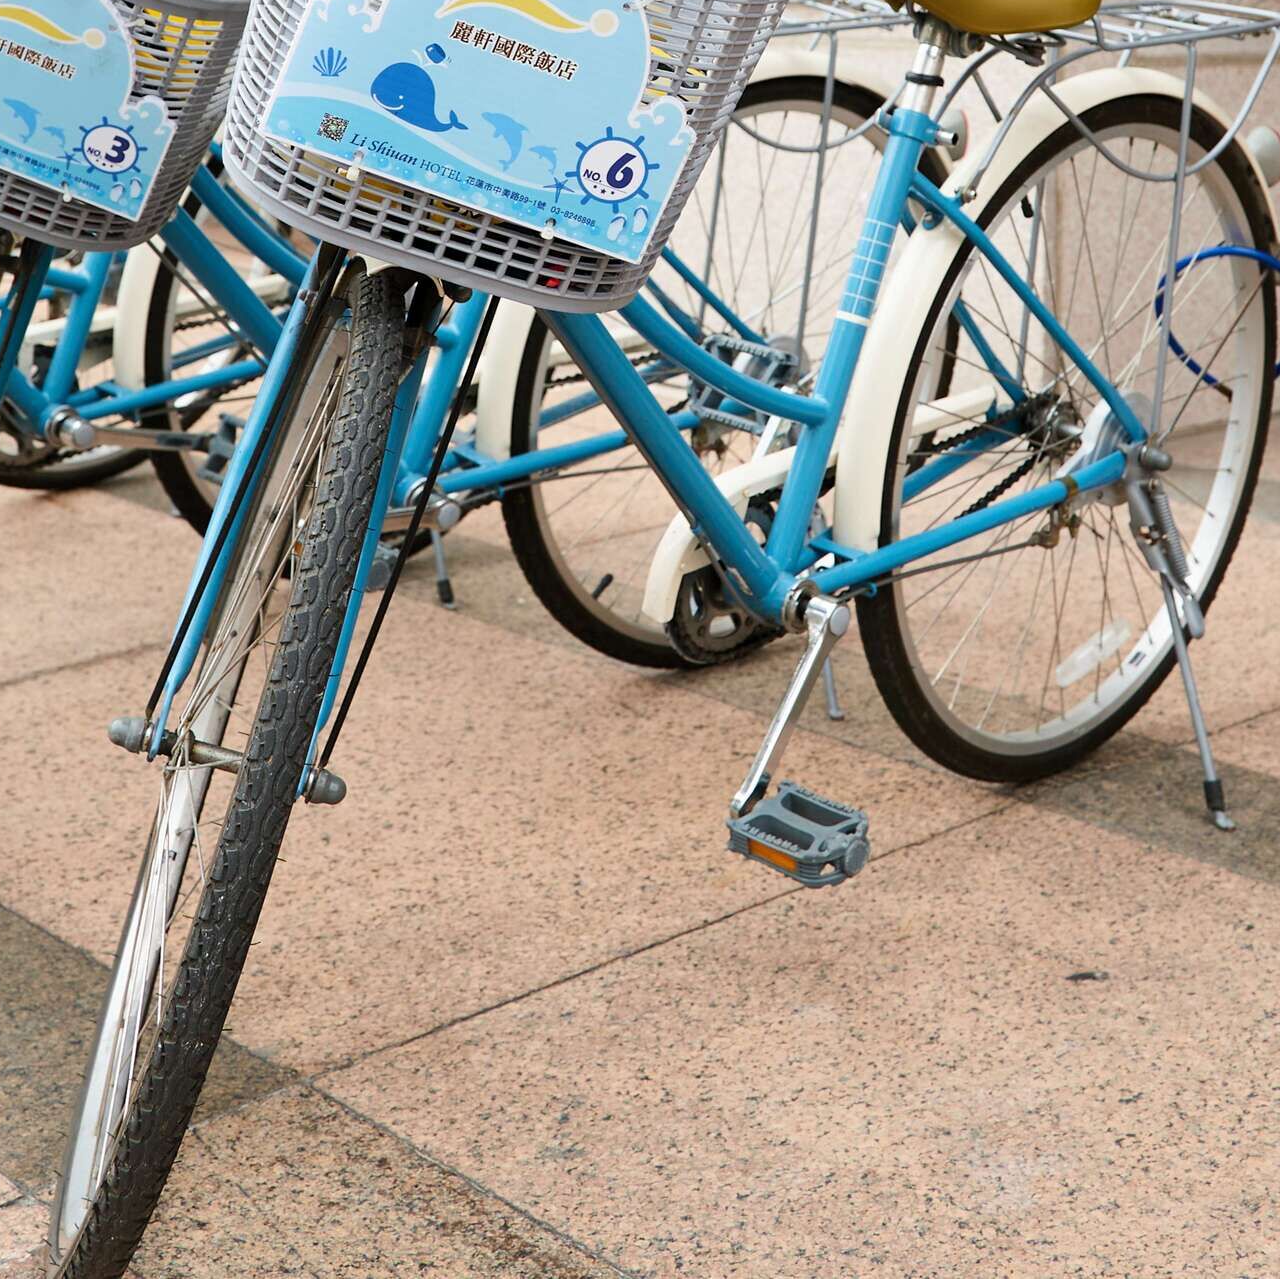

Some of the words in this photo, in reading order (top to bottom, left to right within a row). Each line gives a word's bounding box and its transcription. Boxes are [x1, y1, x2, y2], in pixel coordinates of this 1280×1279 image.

[450, 21, 578, 81] 麗軒國際飯店
[105, 135, 130, 163] 3
[350, 133, 368, 146] Li
[368, 140, 418, 166] Shiuan
[420, 159, 462, 182] HOTEL
[583, 168, 602, 182] NO.
[606, 152, 637, 189] 6
